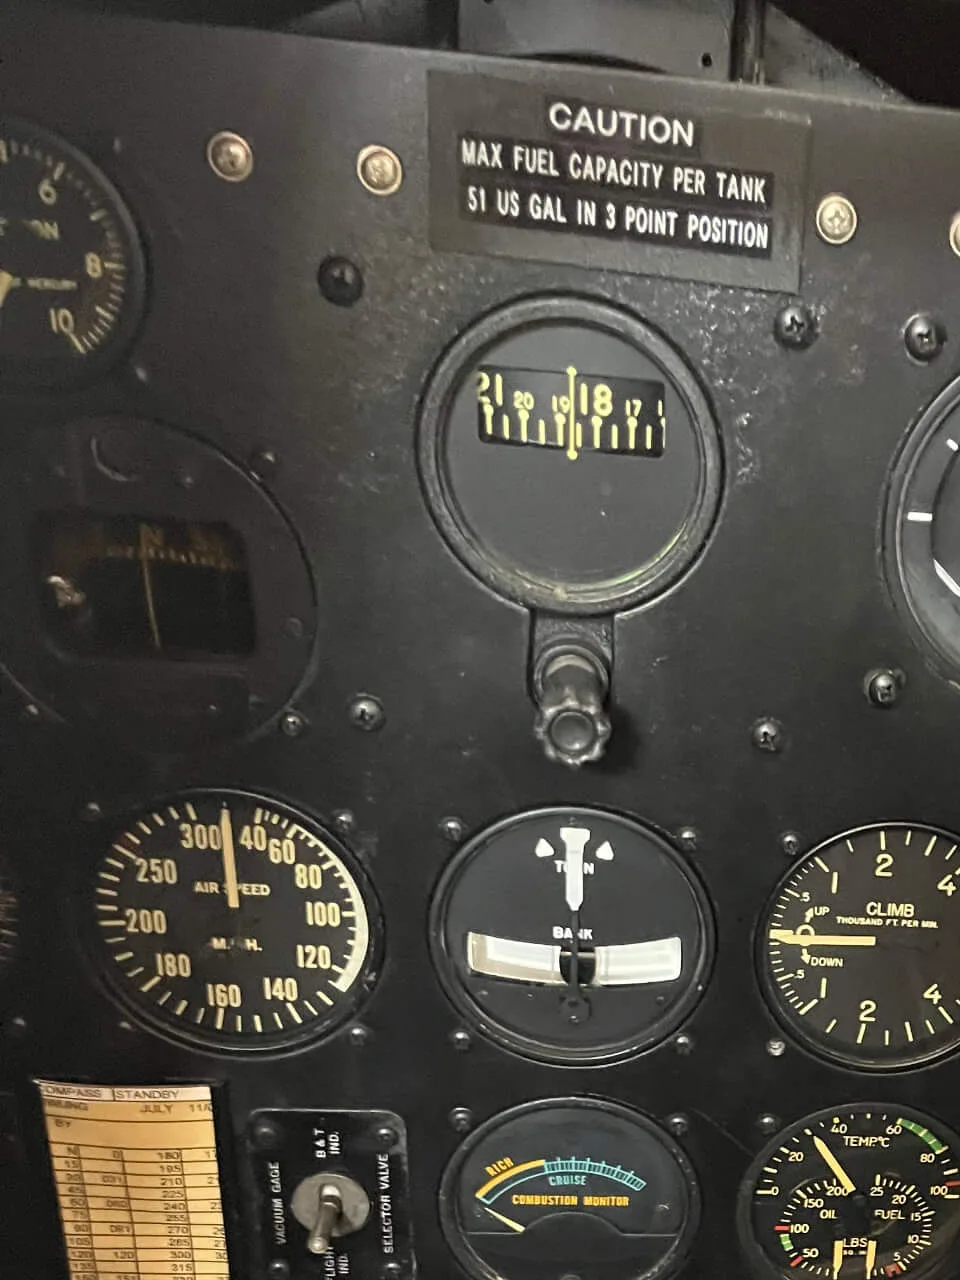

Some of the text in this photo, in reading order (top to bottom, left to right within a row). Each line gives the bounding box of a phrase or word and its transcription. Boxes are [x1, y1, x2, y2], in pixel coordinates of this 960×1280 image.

[549, 102, 694, 147] CAUTION
[461, 137, 766, 203] MAX FUEL CAPACITY PER TANK
[38, 178, 57, 205] 6
[468, 187, 769, 249] 51 US GAL IN 3 POINT POSITION
[85, 252, 103, 278] 8
[50, 308, 74, 334] 10
[513, 390, 535, 410] 20
[580, 382, 613, 417] 18
[625, 399, 642, 417] 17
[179, 823, 221, 850] 300
[240, 825, 267, 850] 40
[268, 839, 295, 864] 60
[135, 858, 177, 884] 250
[875, 853, 893, 877] 2
[294, 863, 322, 889] 80
[937, 874, 956, 896] 4
[194, 881, 219, 893] AIR
[305, 901, 341, 927] 100
[815, 907, 829, 916] UP
[866, 901, 914, 917] CLIMB
[125, 909, 167, 934] 200
[836, 916, 883, 926] THOUSAND
[901, 919, 918, 927] PER
[156, 953, 191, 977] 180
[296, 945, 331, 969] 120
[811, 958, 843, 966] DOWN
[207, 983, 241, 1007] 160
[263, 977, 298, 1001] 140
[923, 984, 941, 1004] 4
[859, 1000, 876, 1022] 2
[116, 1089, 179, 1099] STANDBY
[313, 1128, 325, 1136] T
[830, 1124, 847, 1134] 40
[886, 1125, 902, 1135] 60
[788, 1152, 803, 1161] 20
[920, 1153, 935, 1163] 80
[485, 1157, 514, 1177] RICH
[549, 1175, 586, 1186] CRUISE
[826, 1186, 849, 1196] 200
[870, 1186, 884, 1196] 25
[892, 1195, 906, 1204] 20
[930, 1186, 948, 1195] 100
[377, 1154, 394, 1253] SELECTOR VALVE
[512, 1194, 629, 1206] COMBUSTION MONITOR
[804, 1199, 824, 1208] 150
[273, 1198, 287, 1245] VACUUM
[820, 1210, 837, 1219] OIL
[874, 1210, 905, 1220] FUEL
[910, 1212, 922, 1221] 15
[790, 1224, 810, 1233] 100
[844, 1238, 867, 1247] LBS
[908, 1235, 919, 1244] 10
[803, 1248, 819, 1258] 50
[893, 1252, 901, 1261] 5
